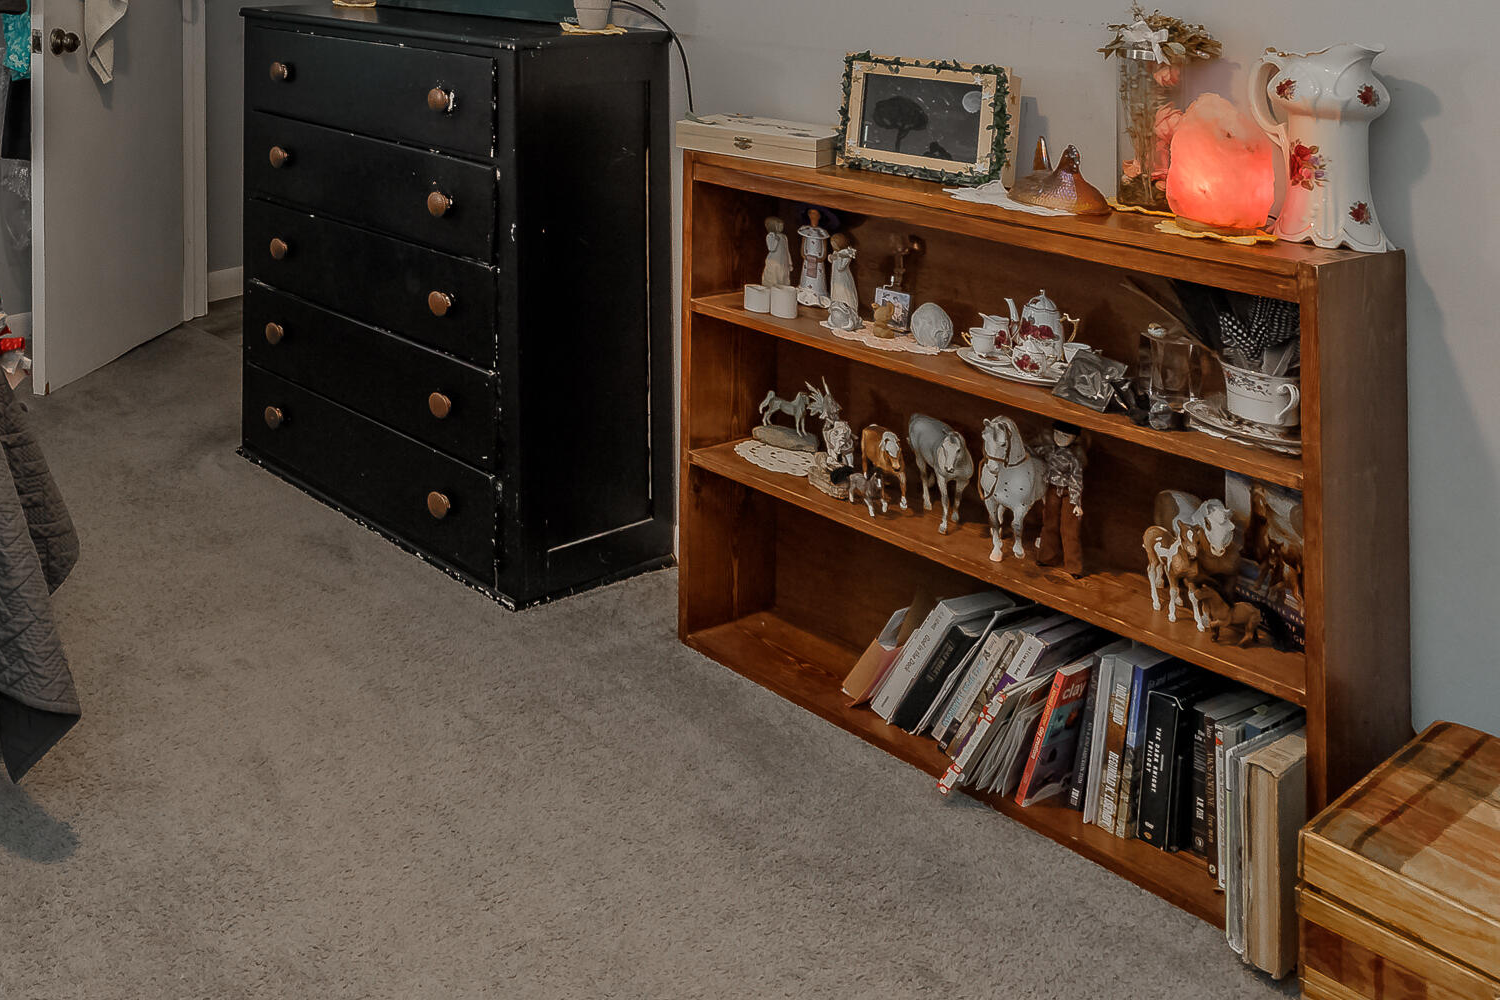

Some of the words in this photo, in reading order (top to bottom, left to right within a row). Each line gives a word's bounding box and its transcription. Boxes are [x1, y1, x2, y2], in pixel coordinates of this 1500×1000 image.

[919, 633, 931, 646] God
[911, 649, 920, 660] the
[903, 657, 916, 673] Dock
[1062, 681, 1086, 700] clay
[1113, 683, 1127, 704] HOLY
[1036, 725, 1045, 736] clay
[1154, 726, 1162, 741] THE
[1144, 740, 1154, 773] TRILOGY
[1152, 743, 1161, 762] DARK
[1149, 765, 1159, 792] KNIGHT
